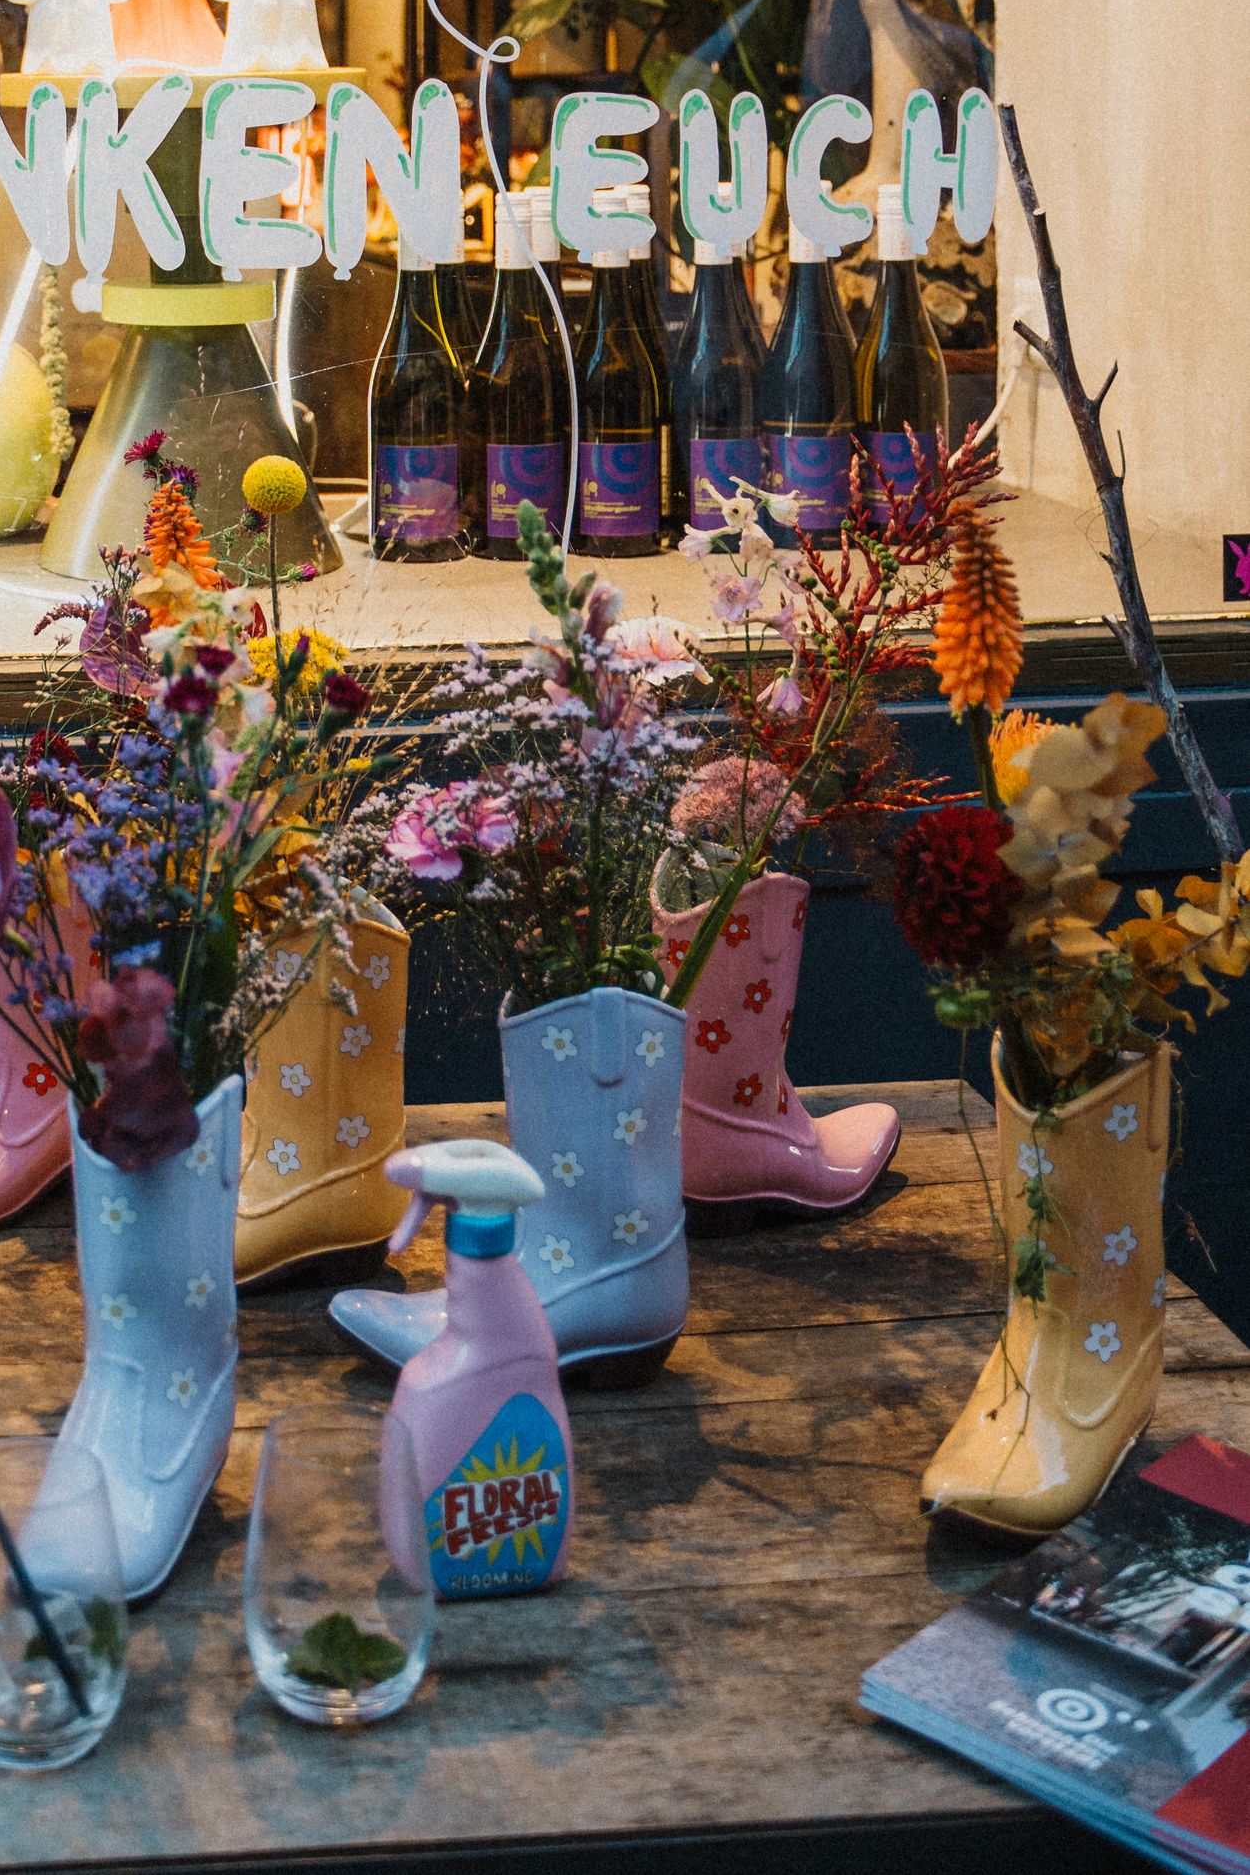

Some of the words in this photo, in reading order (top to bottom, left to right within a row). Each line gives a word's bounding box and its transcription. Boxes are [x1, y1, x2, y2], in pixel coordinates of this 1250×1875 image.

[550, 87, 999, 263] EUCH
[444, 1471, 561, 1531] FLORAL
[446, 1500, 558, 1556] FRESH
